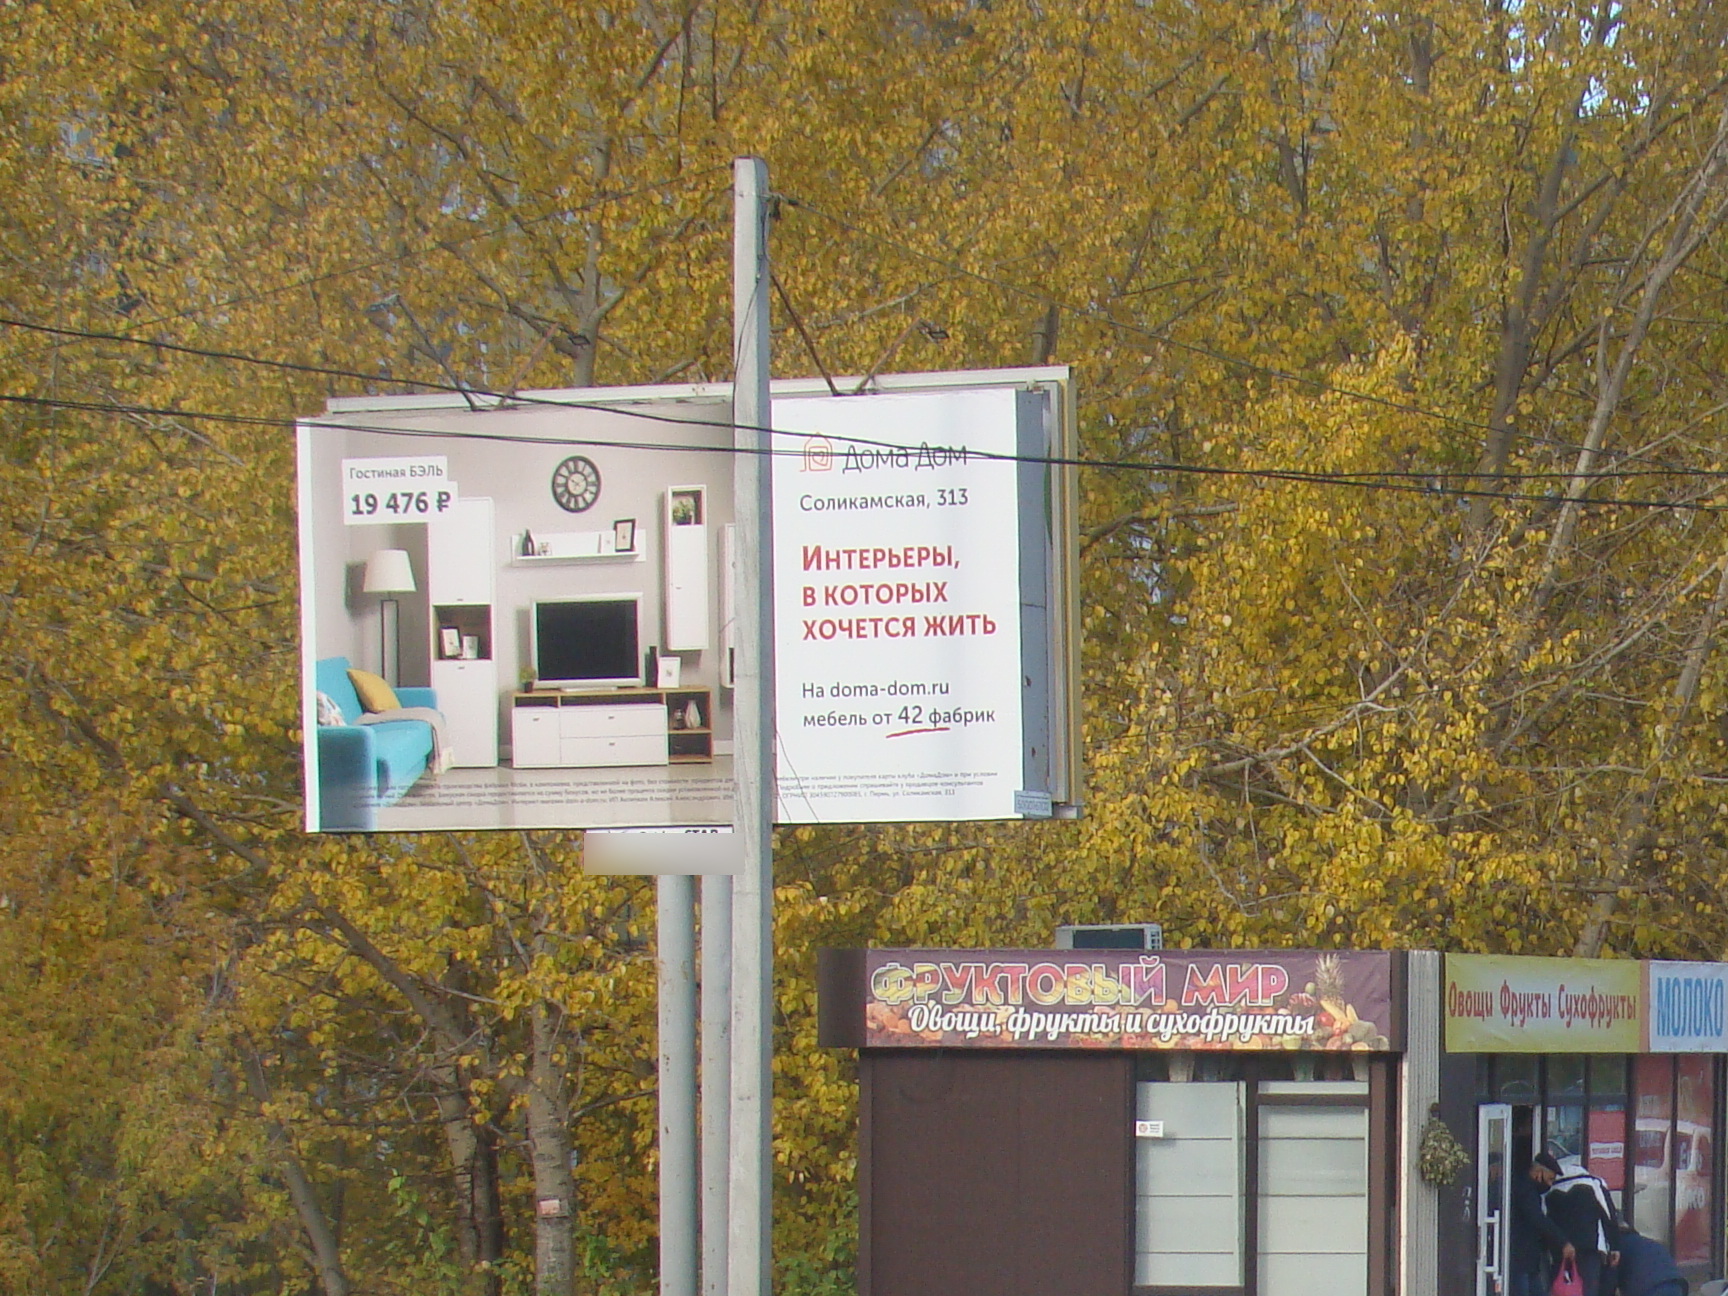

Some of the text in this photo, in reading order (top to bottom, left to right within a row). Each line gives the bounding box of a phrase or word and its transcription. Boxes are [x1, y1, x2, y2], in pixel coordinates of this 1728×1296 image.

[349, 464, 444, 480] Гостиная БЭЛЬ
[351, 493, 379, 516] 19
[385, 491, 429, 514] 476
[800, 488, 969, 512] Соликамская, 313
[802, 680, 950, 699] На doma-dom.ru
[803, 705, 996, 728] мебель от 42 фабрик
[871, 956, 1289, 1007] ФРУКТОВЫЙ МИР
[1449, 979, 1637, 1029] Овощи Фрукты Сухофрукты
[1657, 977, 1724, 1038] МОЛОКО
[908, 1004, 1315, 1045] Овощи, фрукты и сухофрукты
